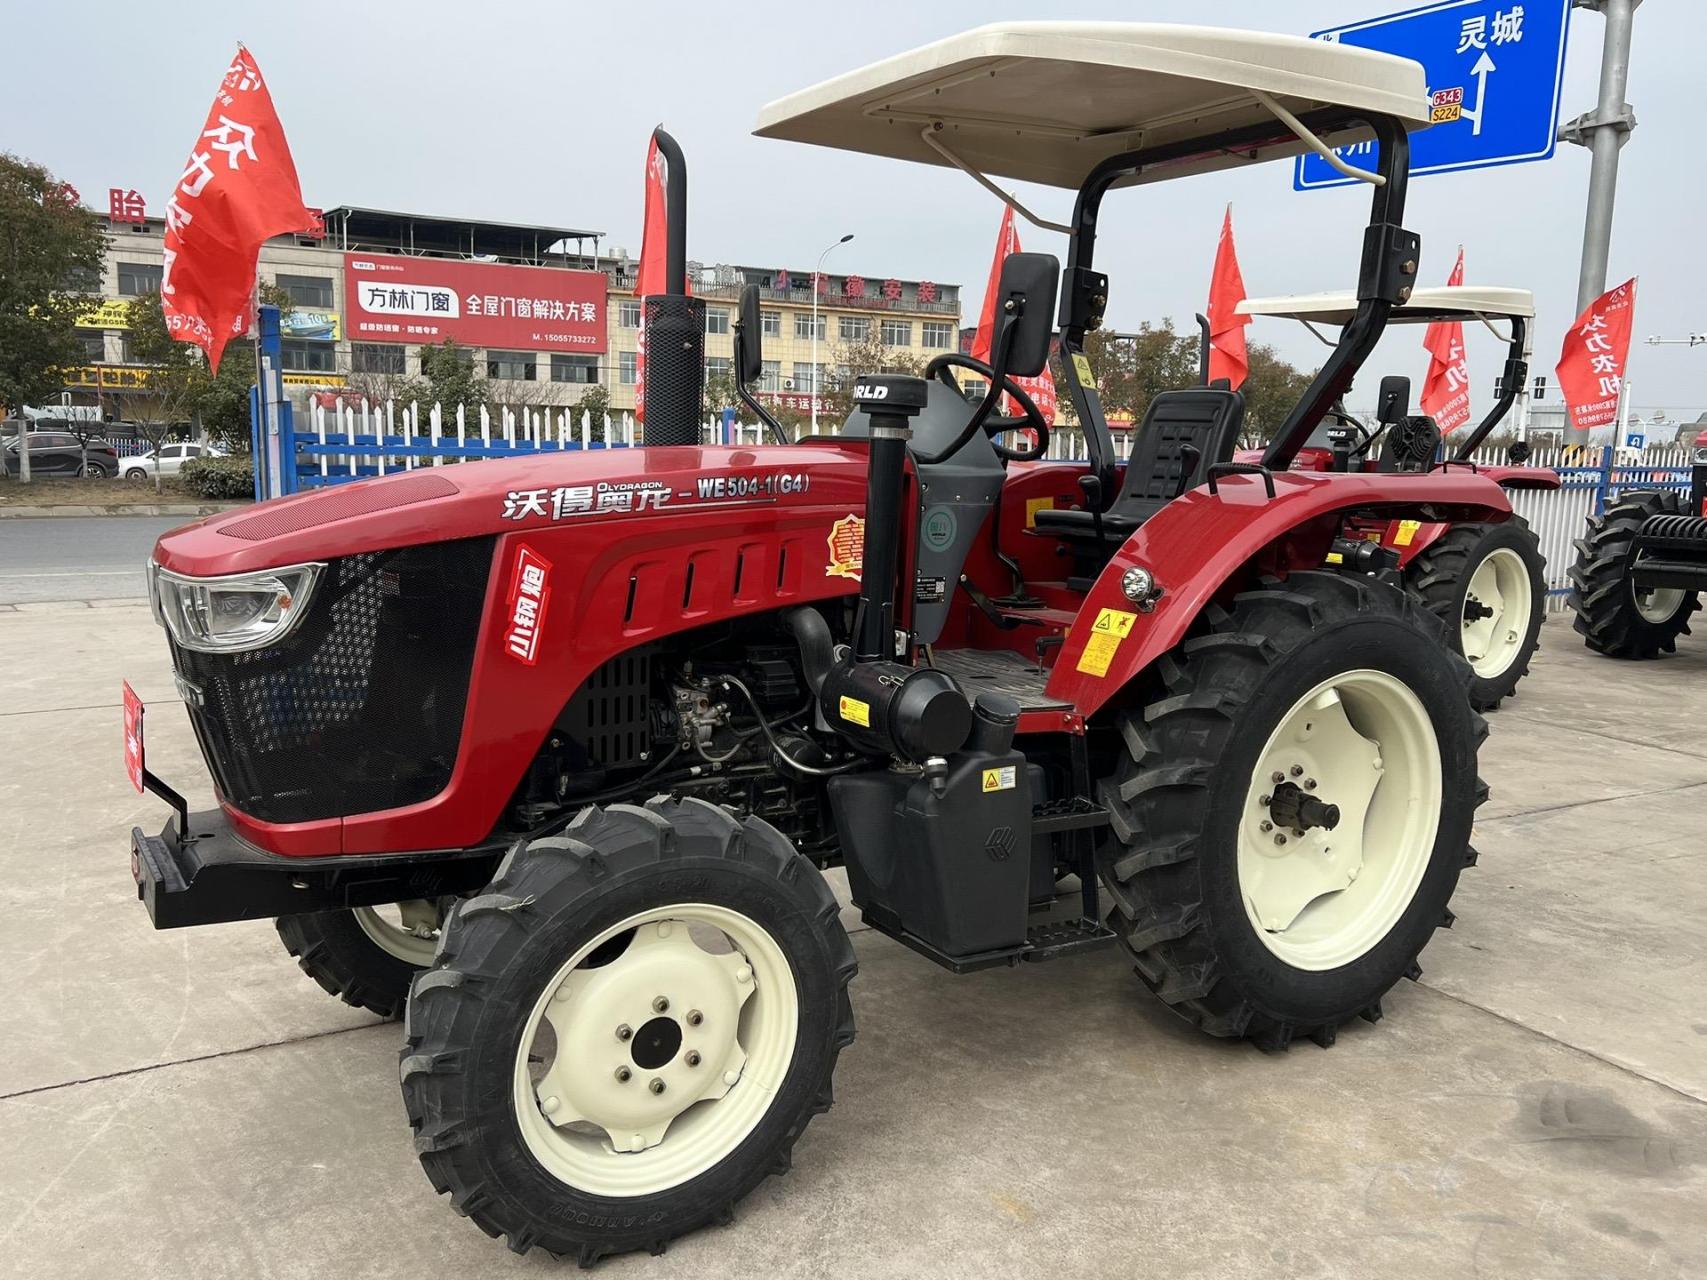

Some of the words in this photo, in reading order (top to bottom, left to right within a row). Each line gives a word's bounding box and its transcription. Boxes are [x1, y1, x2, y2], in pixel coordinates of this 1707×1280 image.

[1456, 5, 1525, 54] 灵城
[1433, 90, 1461, 105] G343
[1433, 108, 1458, 121] S224
[368, 287, 450, 312] 方林门窗
[466, 294, 597, 323] 全屋门窗解决方案
[597, 481, 663, 492] OLYDRAGON
[501, 487, 672, 521] 沃得奥龙
[509, 563, 545, 659] 小钢炮
